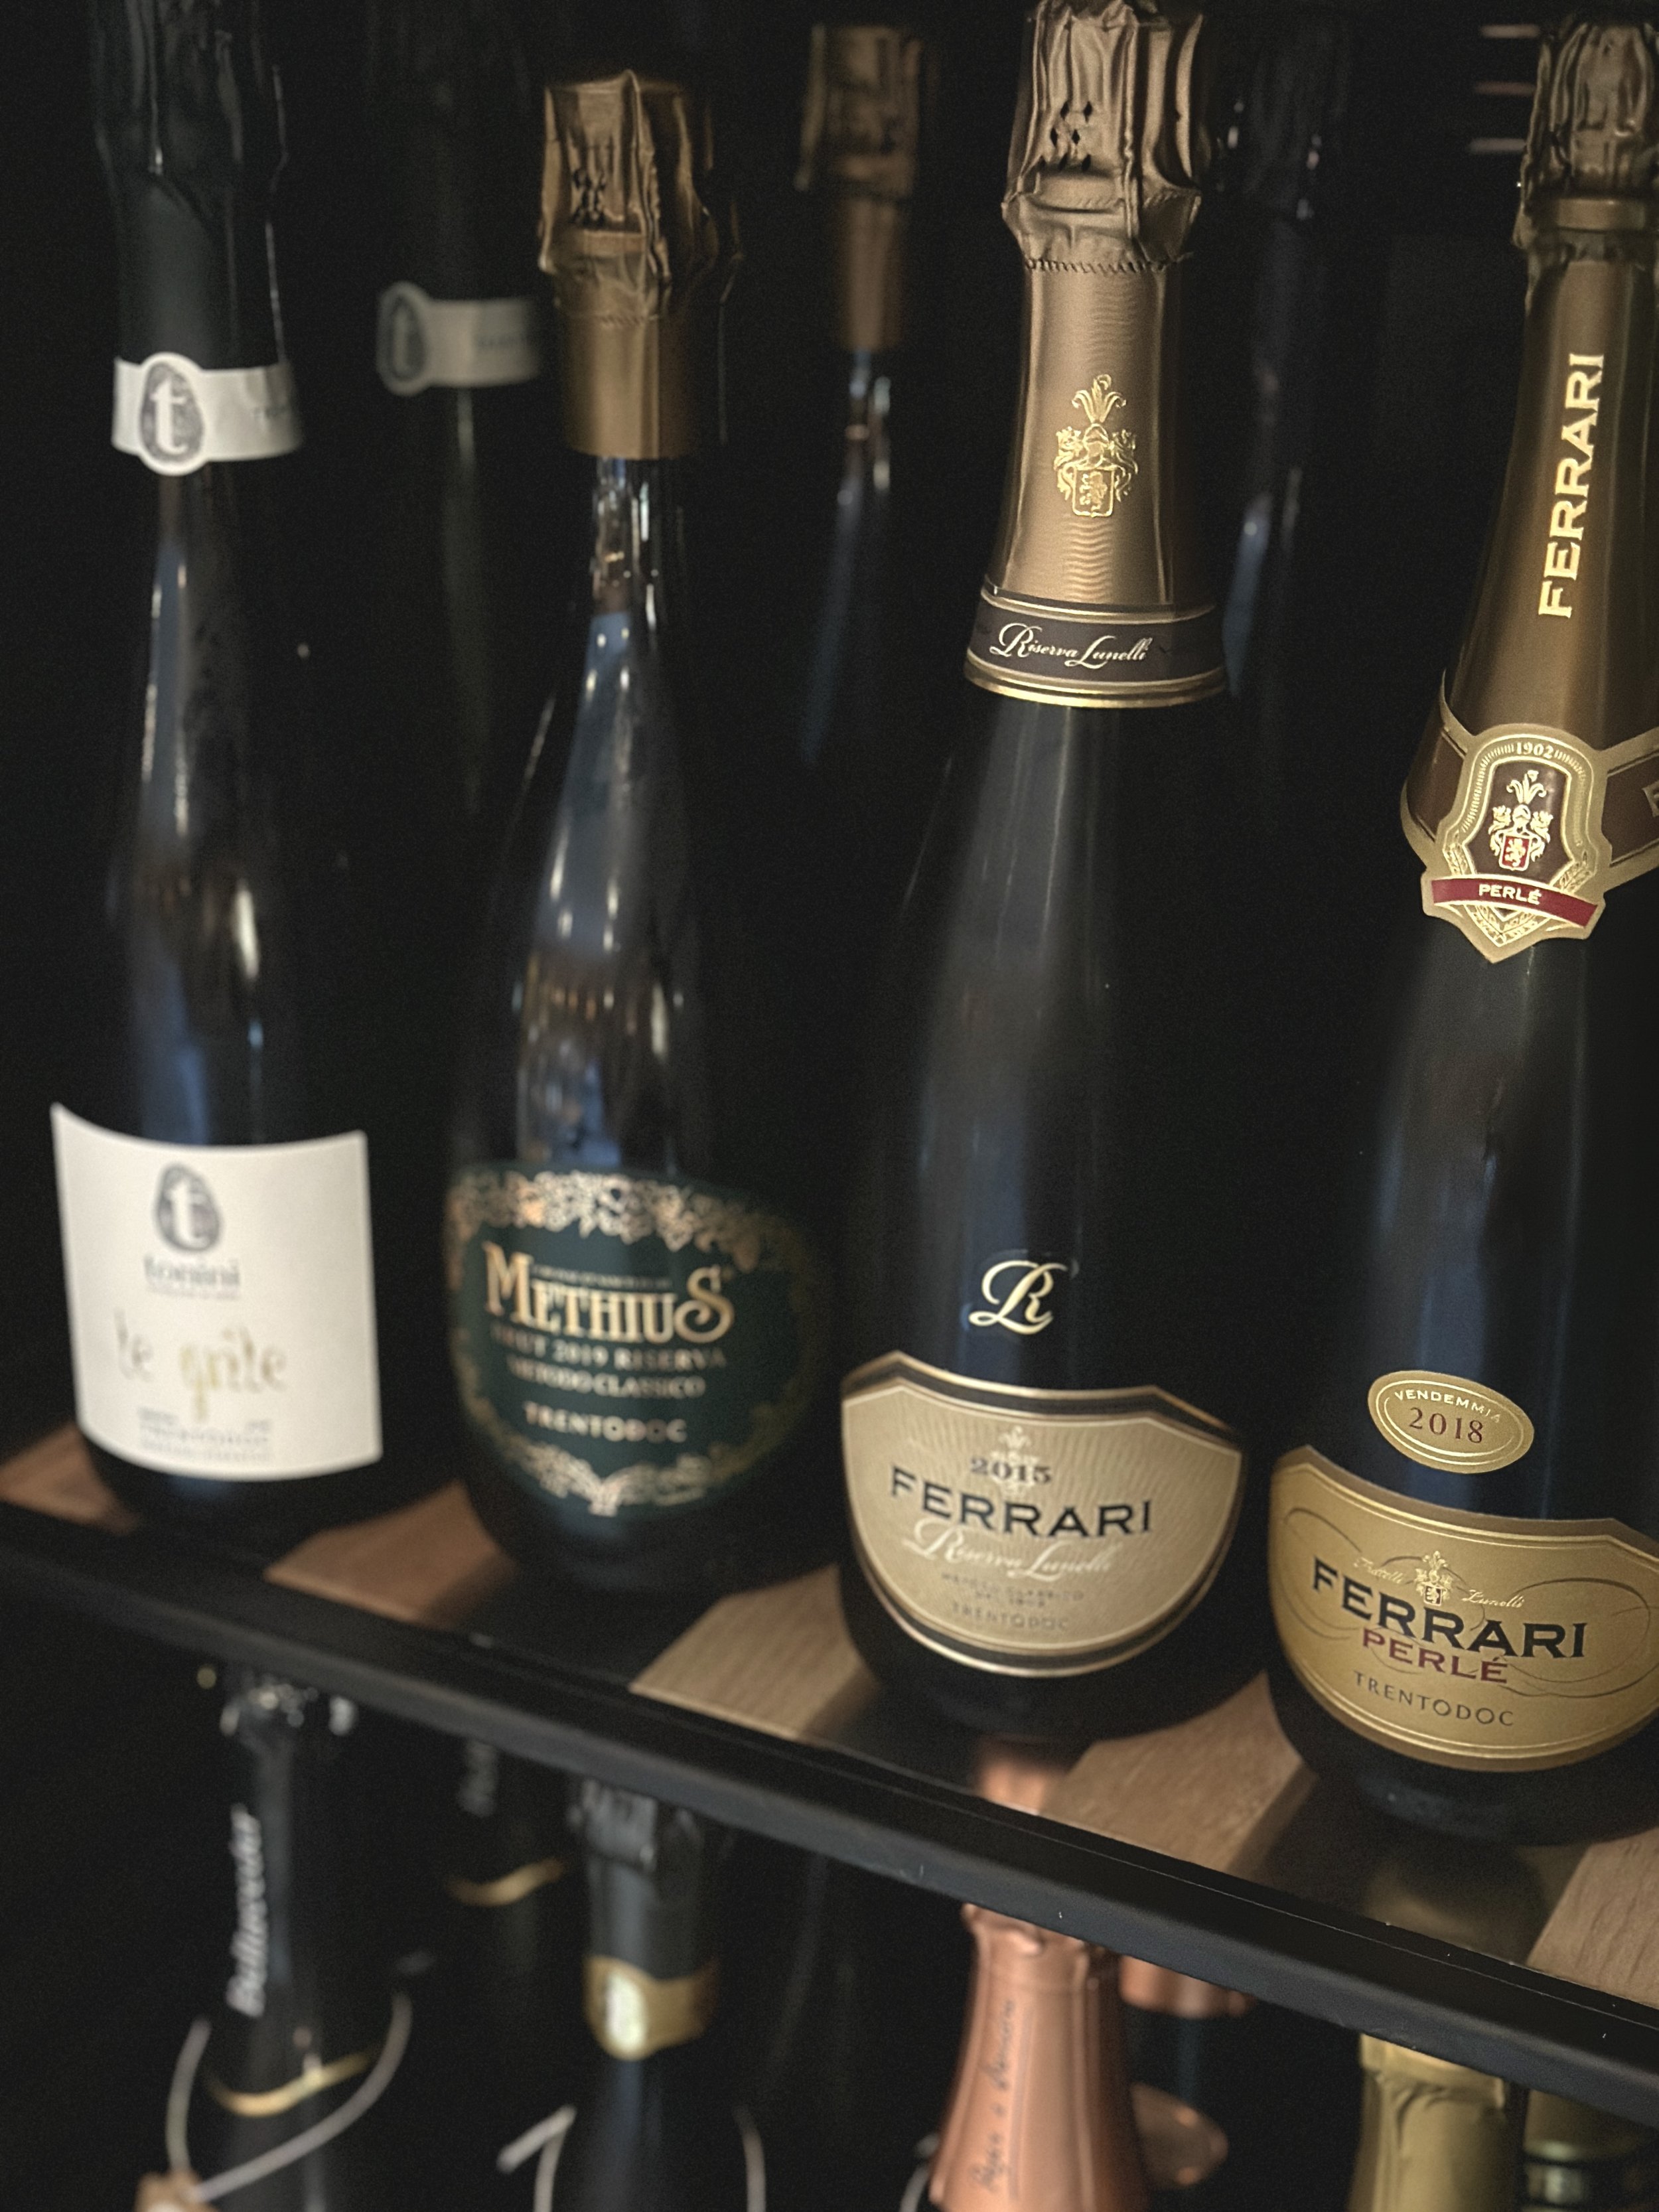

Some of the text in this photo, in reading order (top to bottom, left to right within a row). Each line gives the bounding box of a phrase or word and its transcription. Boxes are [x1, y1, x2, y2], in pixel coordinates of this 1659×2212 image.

[1538, 352, 1605, 619] FERRARI
[989, 622, 1153, 670] Riserva Lunelli
[1516, 742, 1554, 759] 1902
[1479, 883, 1543, 906] PERLÉ
[522, 1399, 688, 1443] TRENTODOC
[1394, 1388, 1503, 1424] VENDEMMIA
[1409, 1406, 1484, 1444] 2018
[971, 1456, 1053, 1486] 2015
[891, 1465, 1152, 1538] FERRARI
[1352, 1556, 1525, 1609] Fratelli Lunelli
[1312, 1555, 1588, 1659] FERRARI
[1362, 1628, 1509, 1684] PERLÉ
[1352, 1670, 1514, 1728] TRENTODOC
